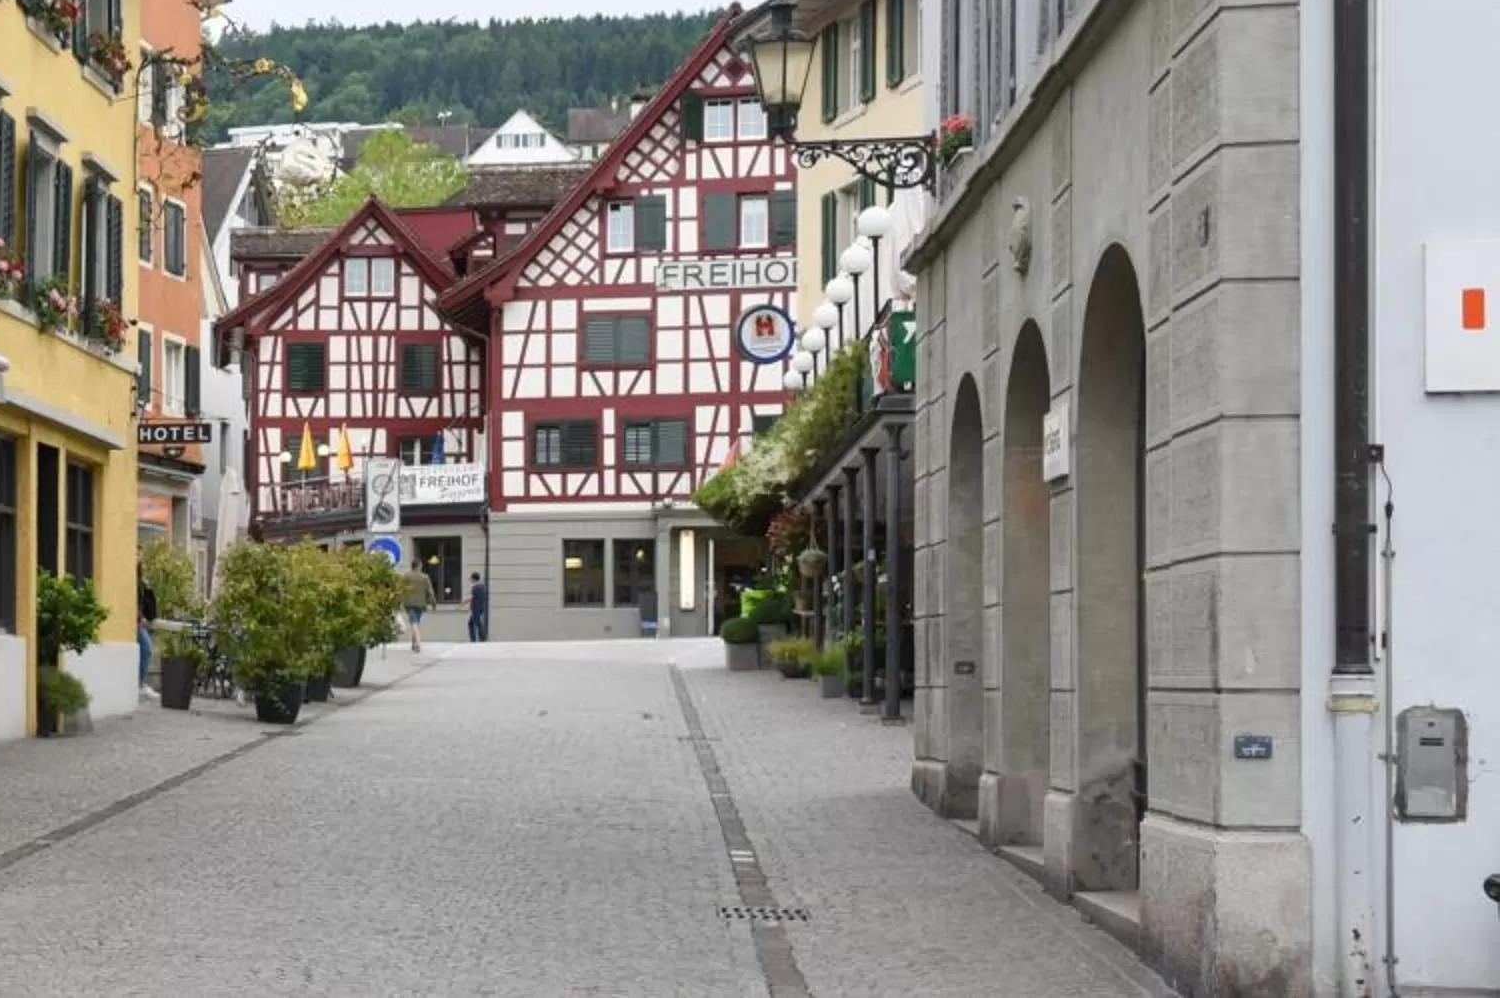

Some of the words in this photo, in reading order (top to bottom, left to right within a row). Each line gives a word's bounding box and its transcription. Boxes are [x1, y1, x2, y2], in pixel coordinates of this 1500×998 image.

[662, 260, 797, 288] FREIHO
[139, 425, 209, 442] HOTEL
[418, 473, 480, 489] FREIHOF
